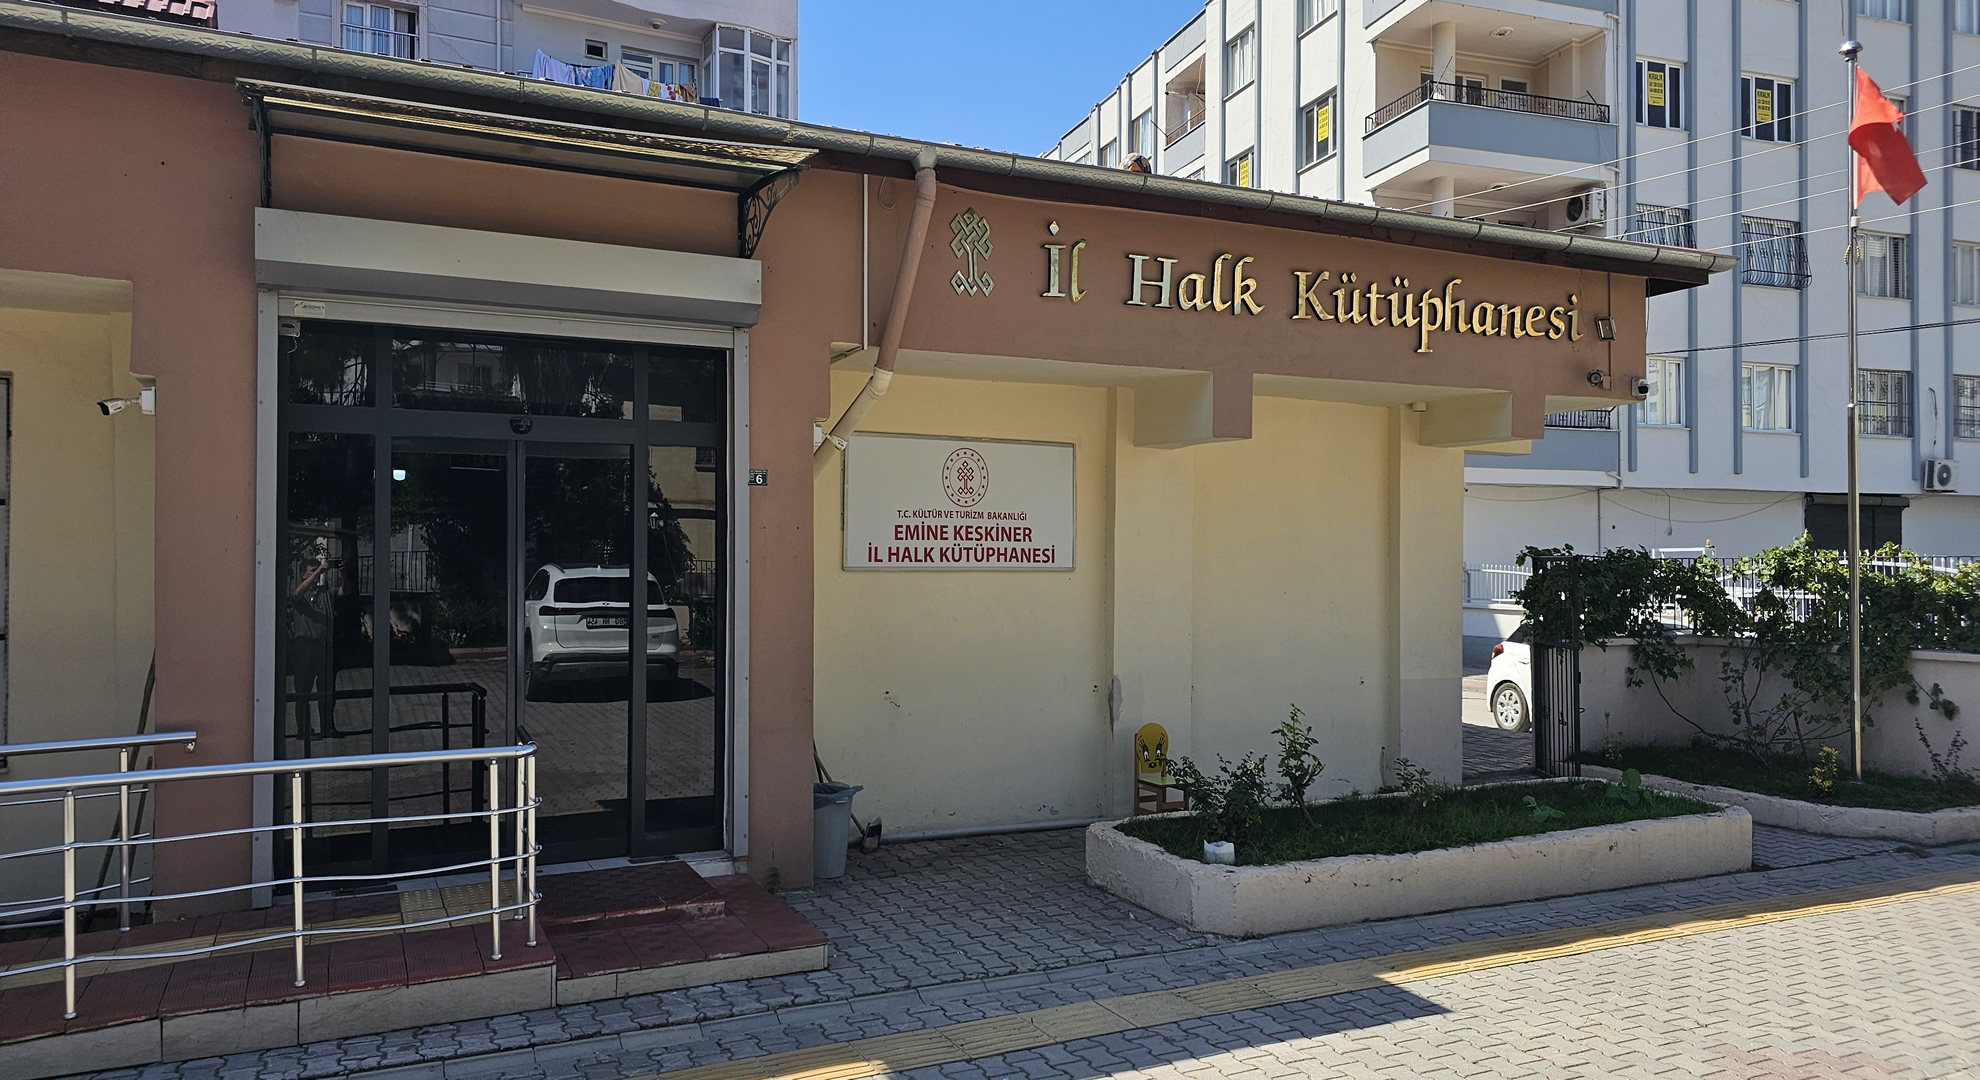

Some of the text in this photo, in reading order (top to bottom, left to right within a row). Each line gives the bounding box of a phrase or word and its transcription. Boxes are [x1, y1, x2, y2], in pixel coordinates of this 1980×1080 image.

[1124, 253, 1266, 316] Halk
[1292, 270, 1584, 353] Kütüphanesi
[756, 474, 763, 484] 6
[897, 508, 1027, 521] T.C. KÜLTÜR VE TURİZM BAKANLIĞI
[894, 521, 1032, 543] EMİNE KESKİNER
[867, 542, 1055, 564] İL HALK KÜTÜPHANESİ
